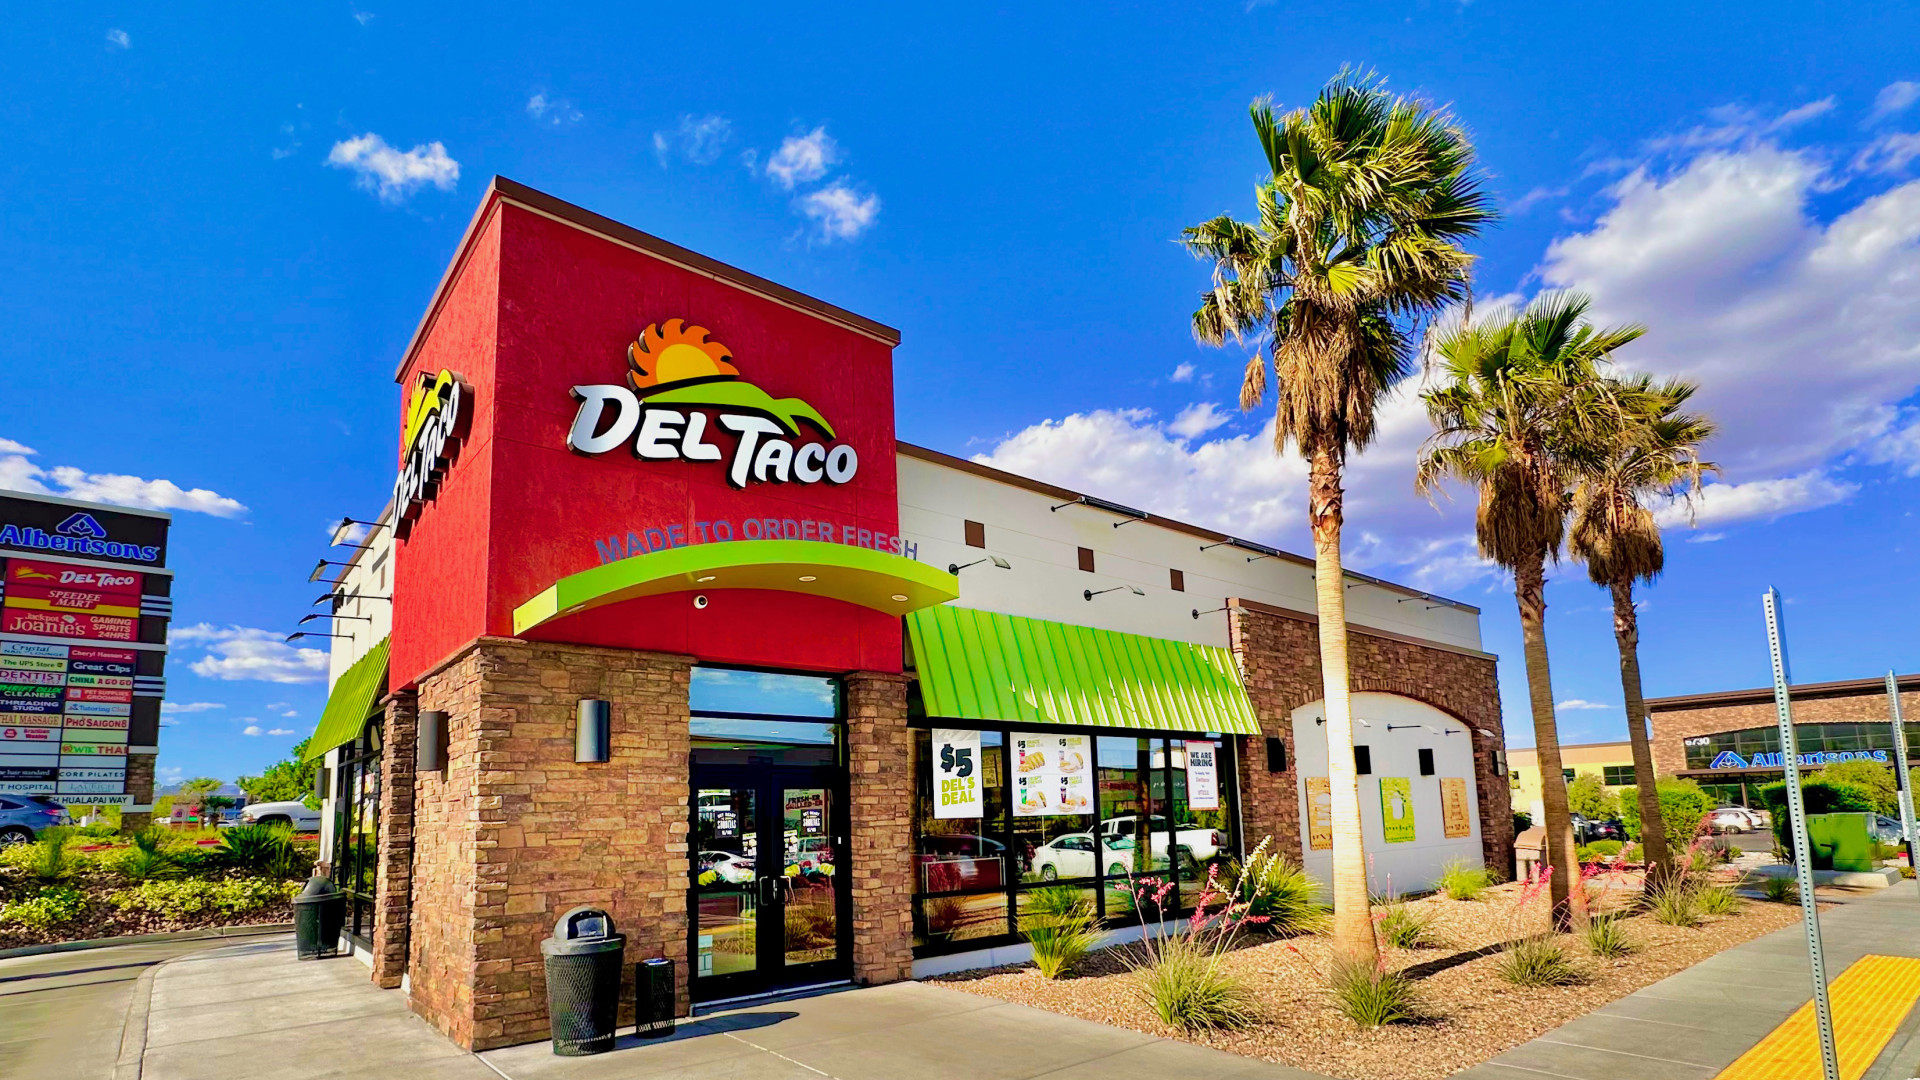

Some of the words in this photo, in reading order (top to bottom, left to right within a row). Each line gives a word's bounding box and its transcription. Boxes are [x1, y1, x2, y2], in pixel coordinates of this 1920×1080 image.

[569, 384, 722, 461] DEL
[717, 413, 858, 487] TACO
[391, 451, 418, 537] DEL
[418, 381, 460, 499] TACO
[0, 524, 160, 562] Albertsons
[595, 524, 687, 566] MADE
[694, 520, 733, 544] TO
[743, 518, 838, 543] ORDER
[842, 525, 918, 561] FRESH
[59, 570, 96, 584] DEL
[96, 573, 134, 587] TACO
[48, 590, 102, 602] SPEEDEE
[56, 598, 94, 608] MART
[25, 613, 59, 623] Jackpot
[90, 616, 132, 626] GAMING
[10, 616, 86, 635] Joanie's
[92, 624, 131, 633] SPIRITS
[98, 631, 131, 640] 24HRS
[12, 643, 51, 652] Crystal
[73, 661, 104, 671] Great
[106, 664, 131, 674] Clips
[0, 670, 63, 681] DENTIST
[69, 676, 95, 684] CHINA
[4, 690, 57, 698] CLEANERS
[20, 715, 60, 725] MASSAGE
[940, 743, 973, 777] $5
[1190, 751, 1199, 759] WE
[1200, 751, 1212, 759] ARE
[1190, 758, 1213, 767] HIRING
[8, 783, 54, 791] HOSPITAL
[941, 776, 976, 793] DEL'S
[61, 796, 107, 804] HUALAPAI
[941, 790, 976, 806] DEAL
